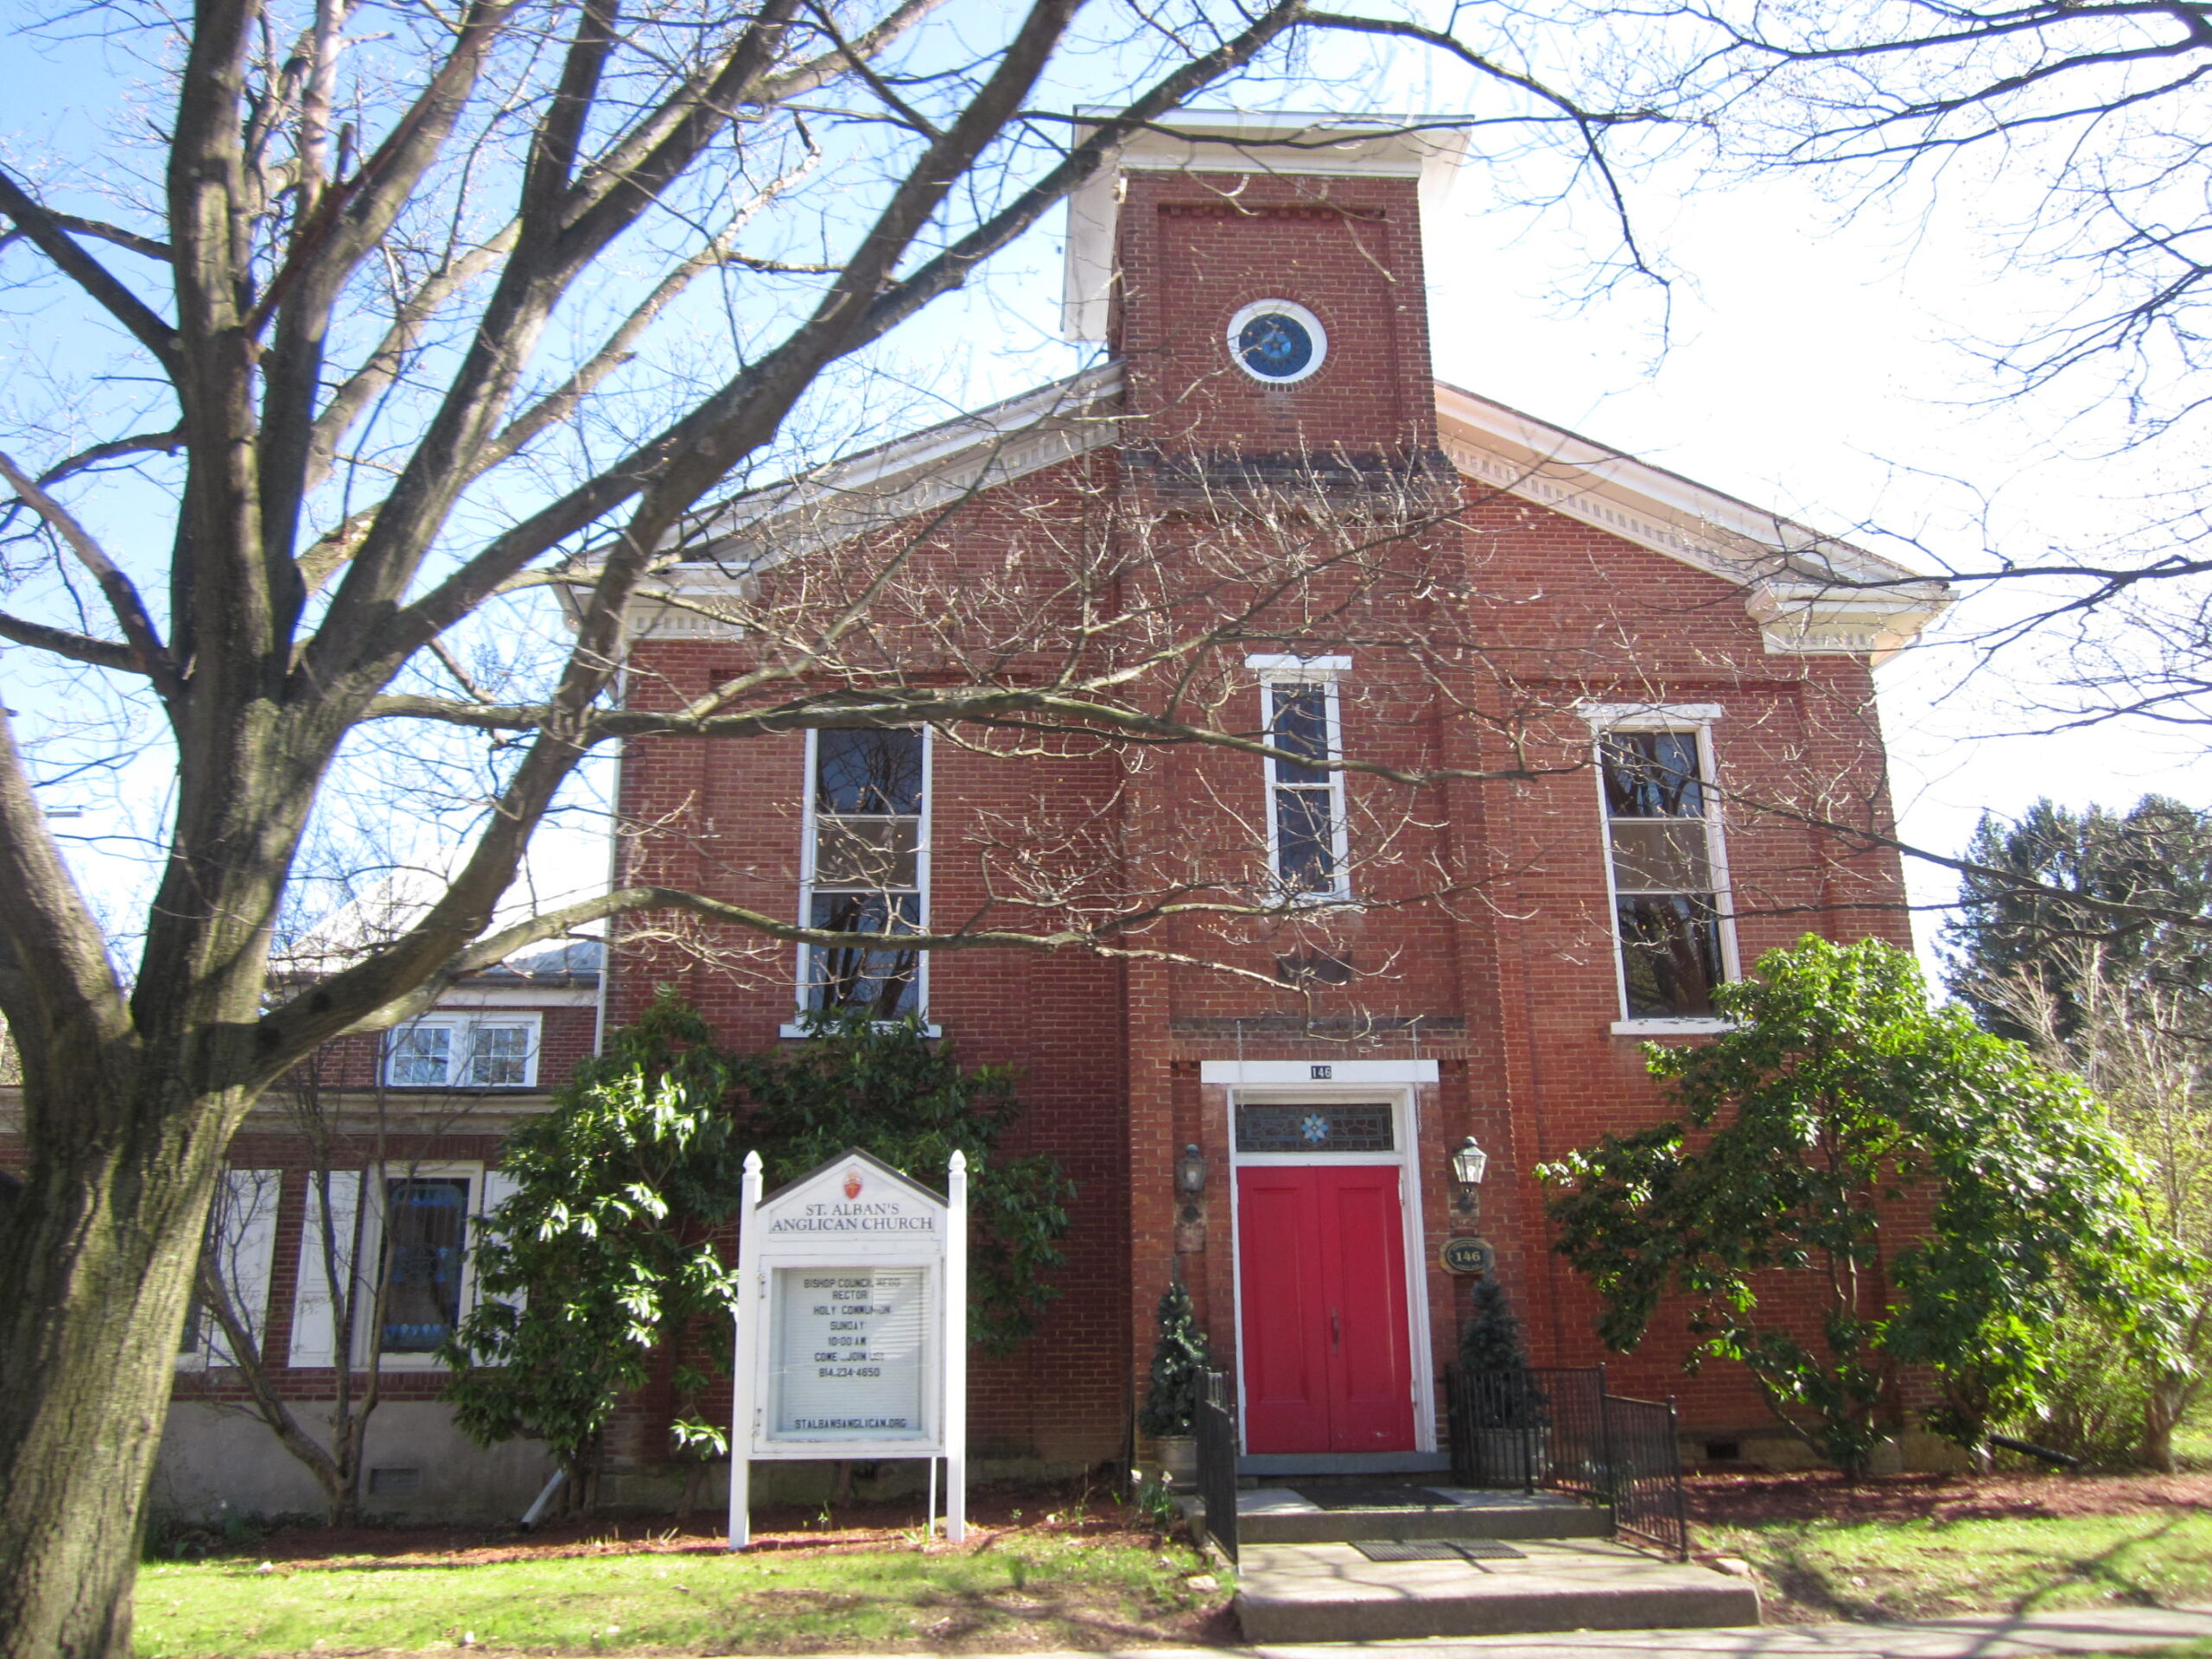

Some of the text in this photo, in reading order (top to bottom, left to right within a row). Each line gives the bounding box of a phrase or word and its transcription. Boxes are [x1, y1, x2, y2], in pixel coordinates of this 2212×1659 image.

[1312, 1066, 1332, 1078] 146
[805, 1203, 899, 1216] ST. ALBAN'S
[772, 1217, 932, 1231] ANGLICAN CHURCH
[1455, 1251, 1481, 1262] 146
[804, 1279, 836, 1288] BISHOP
[832, 1291, 868, 1300] RECTOR
[813, 1306, 836, 1315] HOLY
[830, 1321, 865, 1331] SUNDAY
[855, 1337, 867, 1345] AM
[815, 1352, 838, 1362] COME
